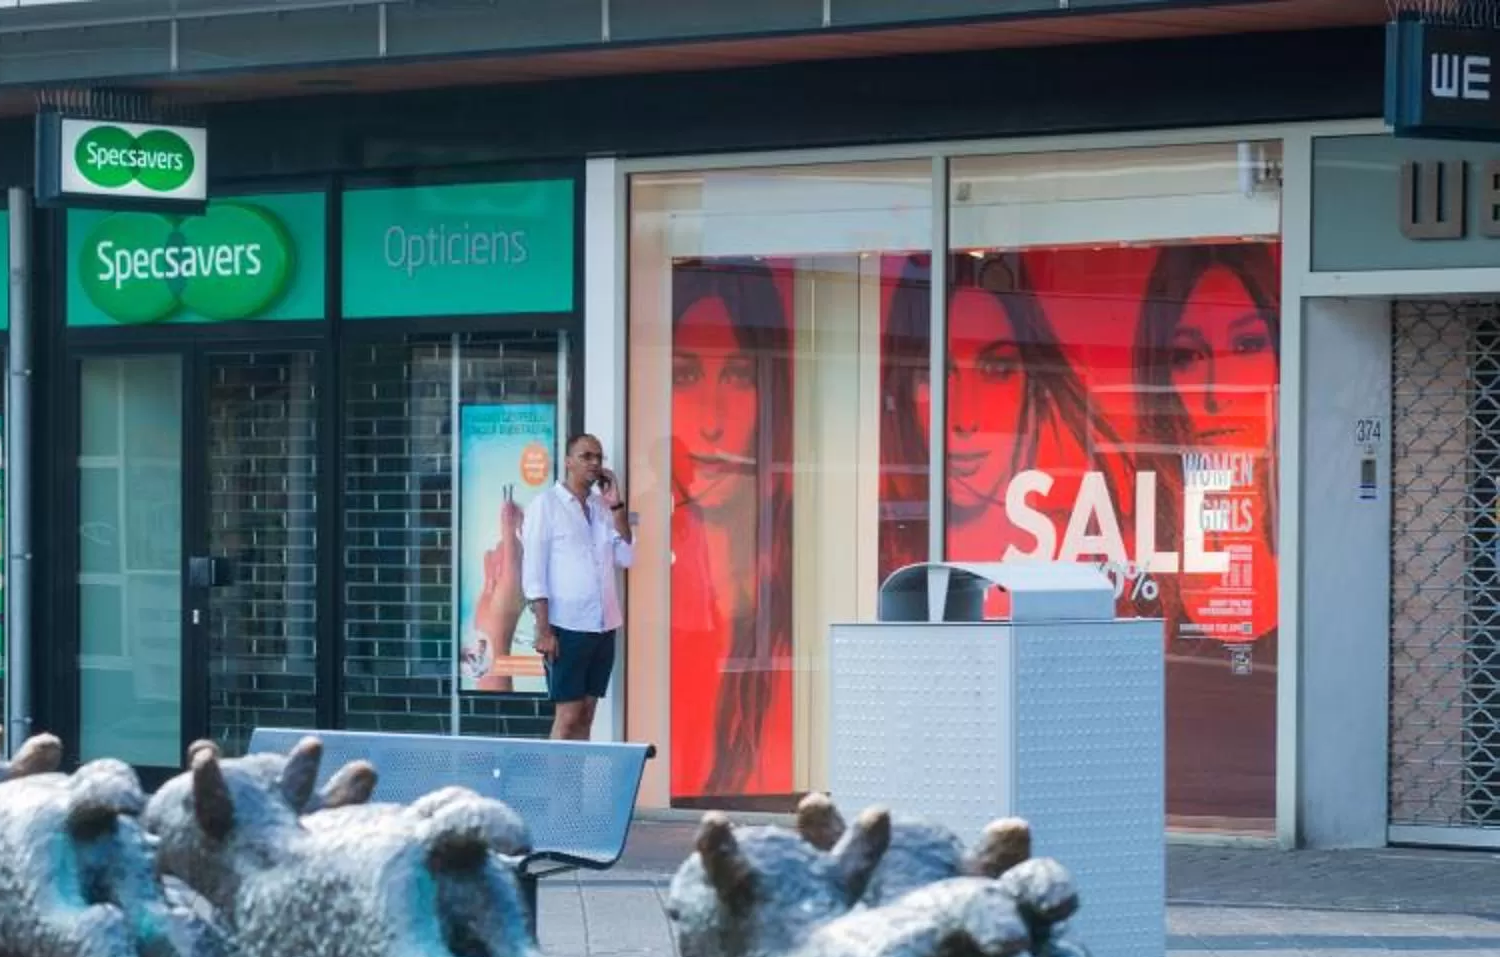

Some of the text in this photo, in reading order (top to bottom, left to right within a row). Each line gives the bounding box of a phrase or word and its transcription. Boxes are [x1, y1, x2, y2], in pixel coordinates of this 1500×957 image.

[1431, 53, 1491, 99] WE
[87, 141, 184, 171] Specsavers
[96, 241, 262, 290] Specsavers
[385, 221, 528, 279] Opticiens
[1182, 453, 1253, 487] WOMEN
[1001, 469, 1232, 573] SALE
[1199, 498, 1253, 532] GIRLS
